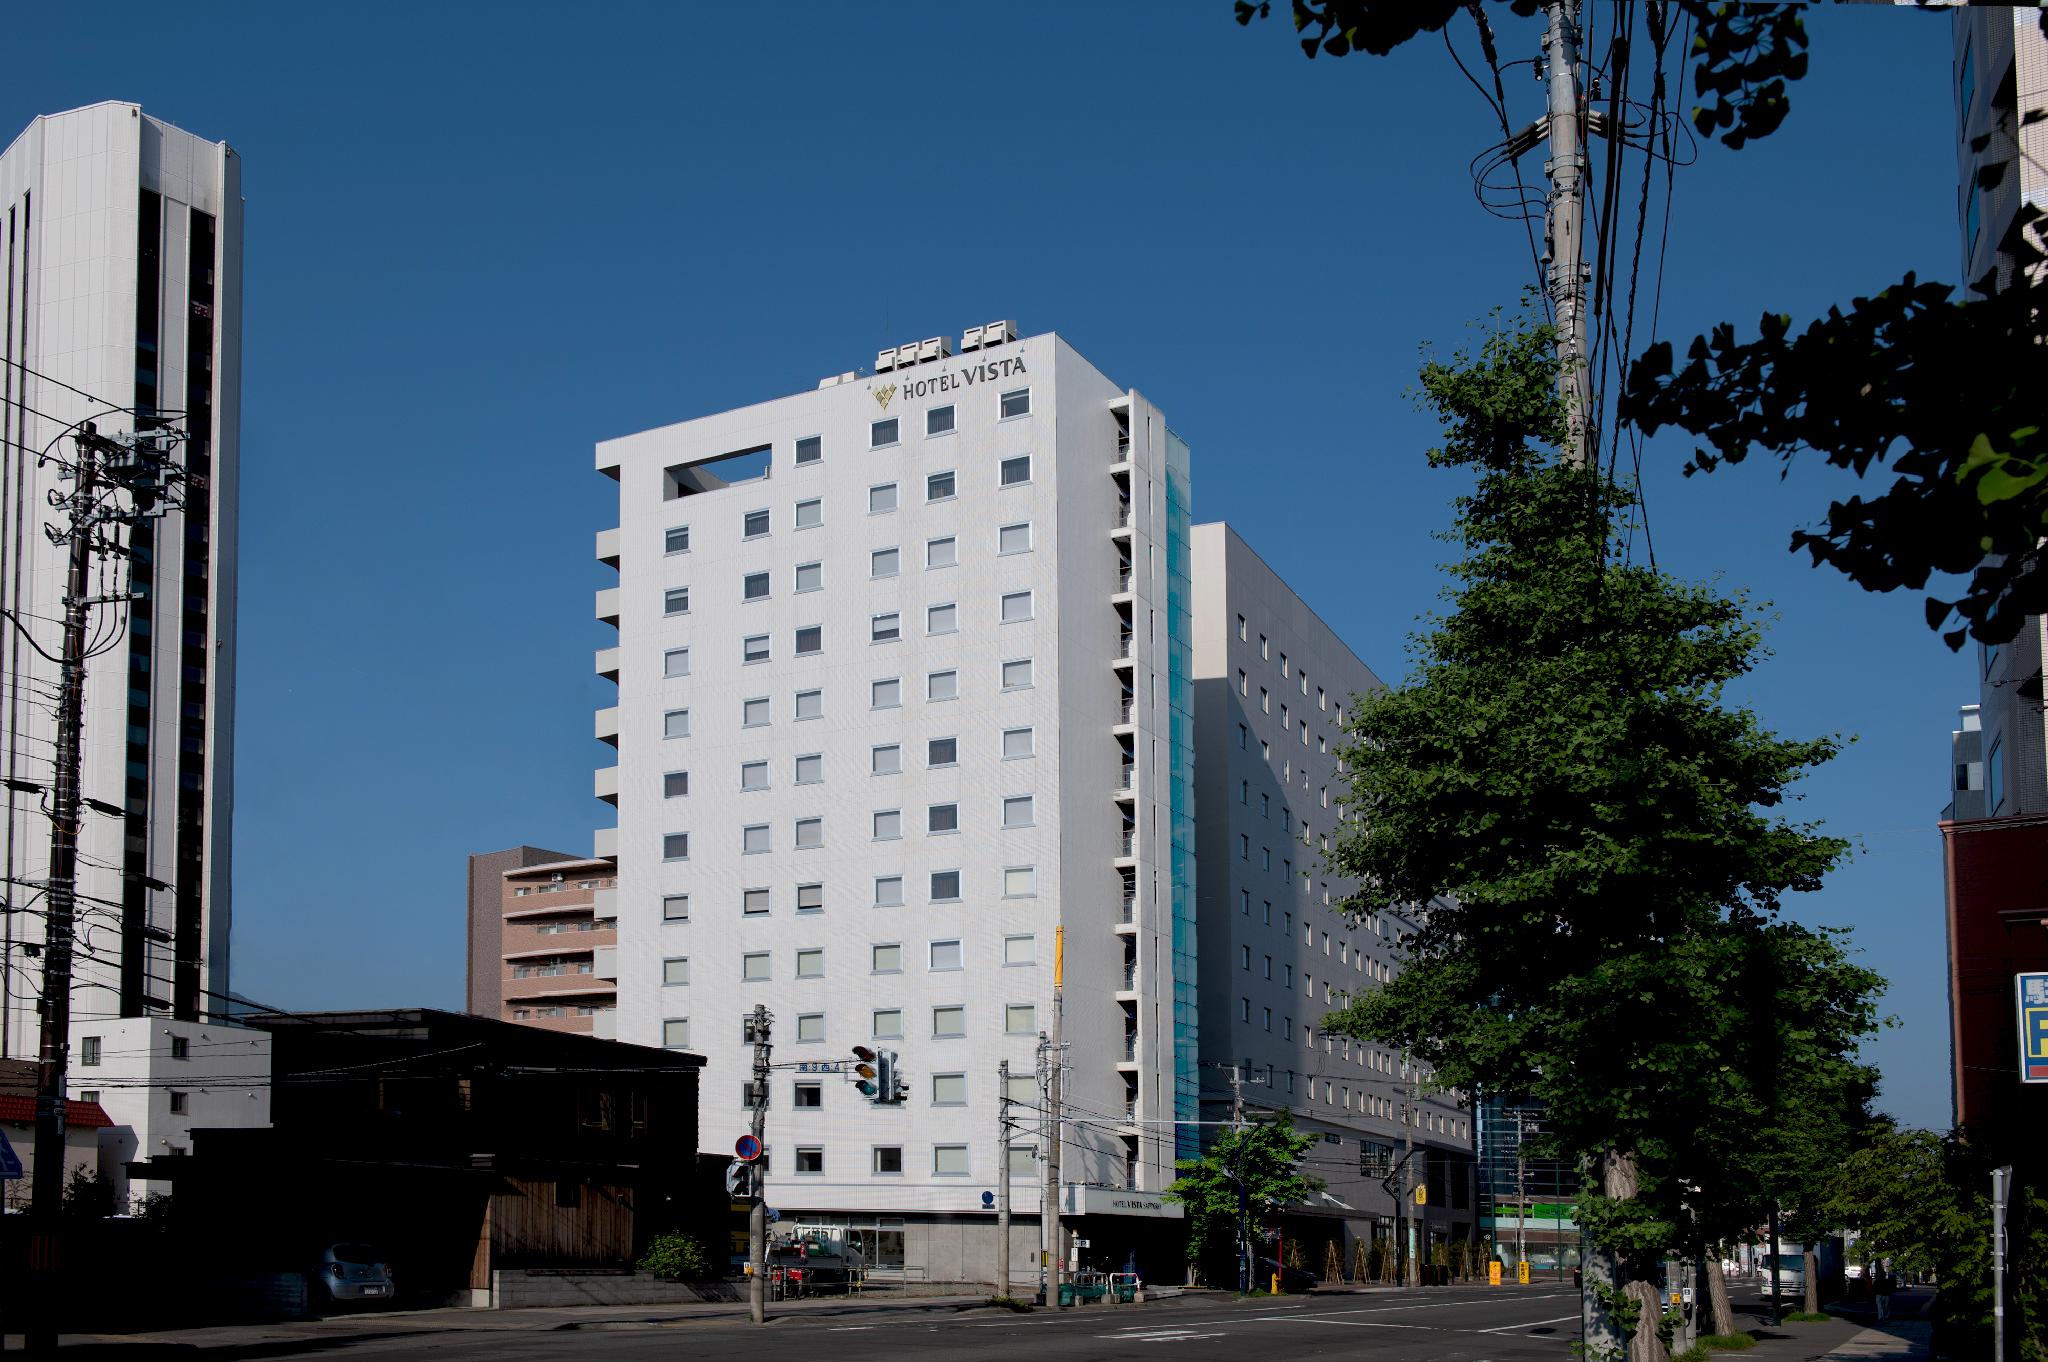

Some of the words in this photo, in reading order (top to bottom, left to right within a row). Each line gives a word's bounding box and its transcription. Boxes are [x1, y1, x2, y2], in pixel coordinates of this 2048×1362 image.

[903, 374, 959, 400] HOTEL
[961, 356, 1027, 386] VISTA
[1112, 1200, 1126, 1208] HOTEL
[1127, 1201, 1142, 1209] VISTA
